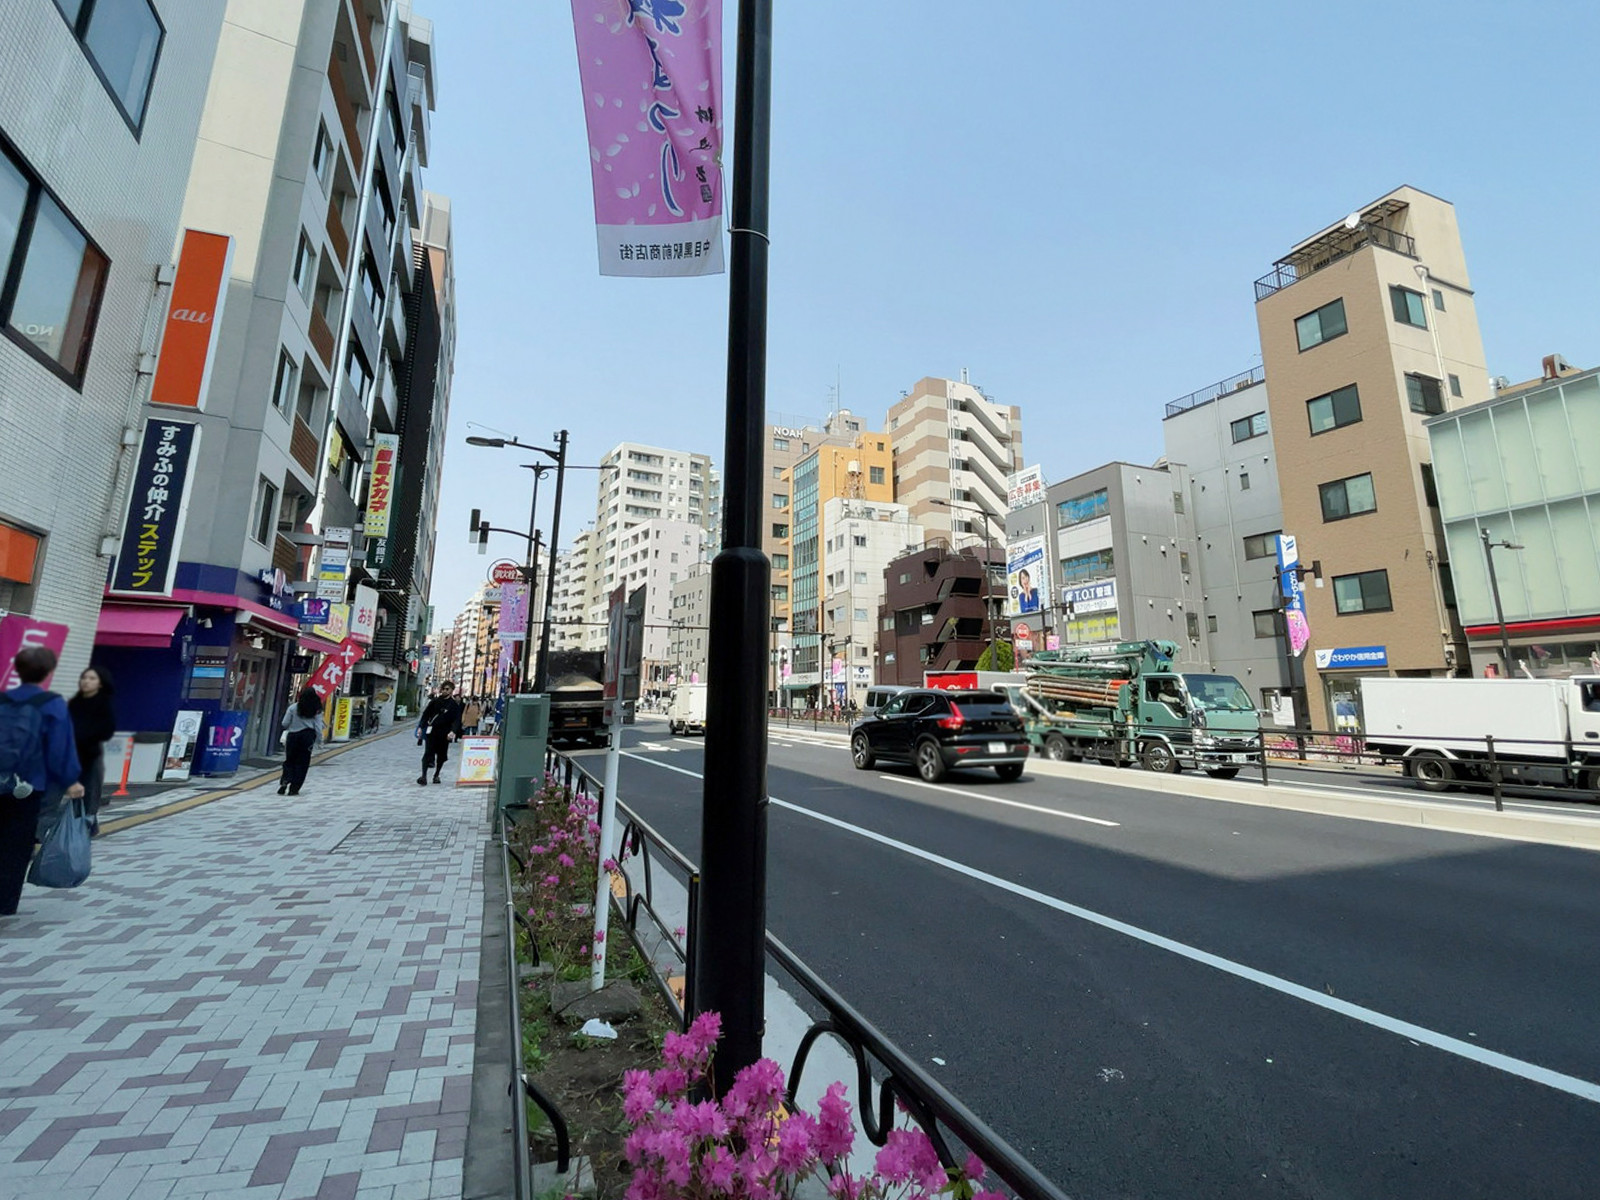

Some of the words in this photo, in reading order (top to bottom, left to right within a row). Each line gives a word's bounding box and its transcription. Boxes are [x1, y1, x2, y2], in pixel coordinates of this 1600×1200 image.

[172, 309, 211, 323] au
[773, 425, 803, 439] NOAH
[1009, 480, 1041, 500] 広告募集
[132, 426, 180, 588] すみふの仲介ステップ
[1332, 652, 1385, 662] さわやか信用金庫
